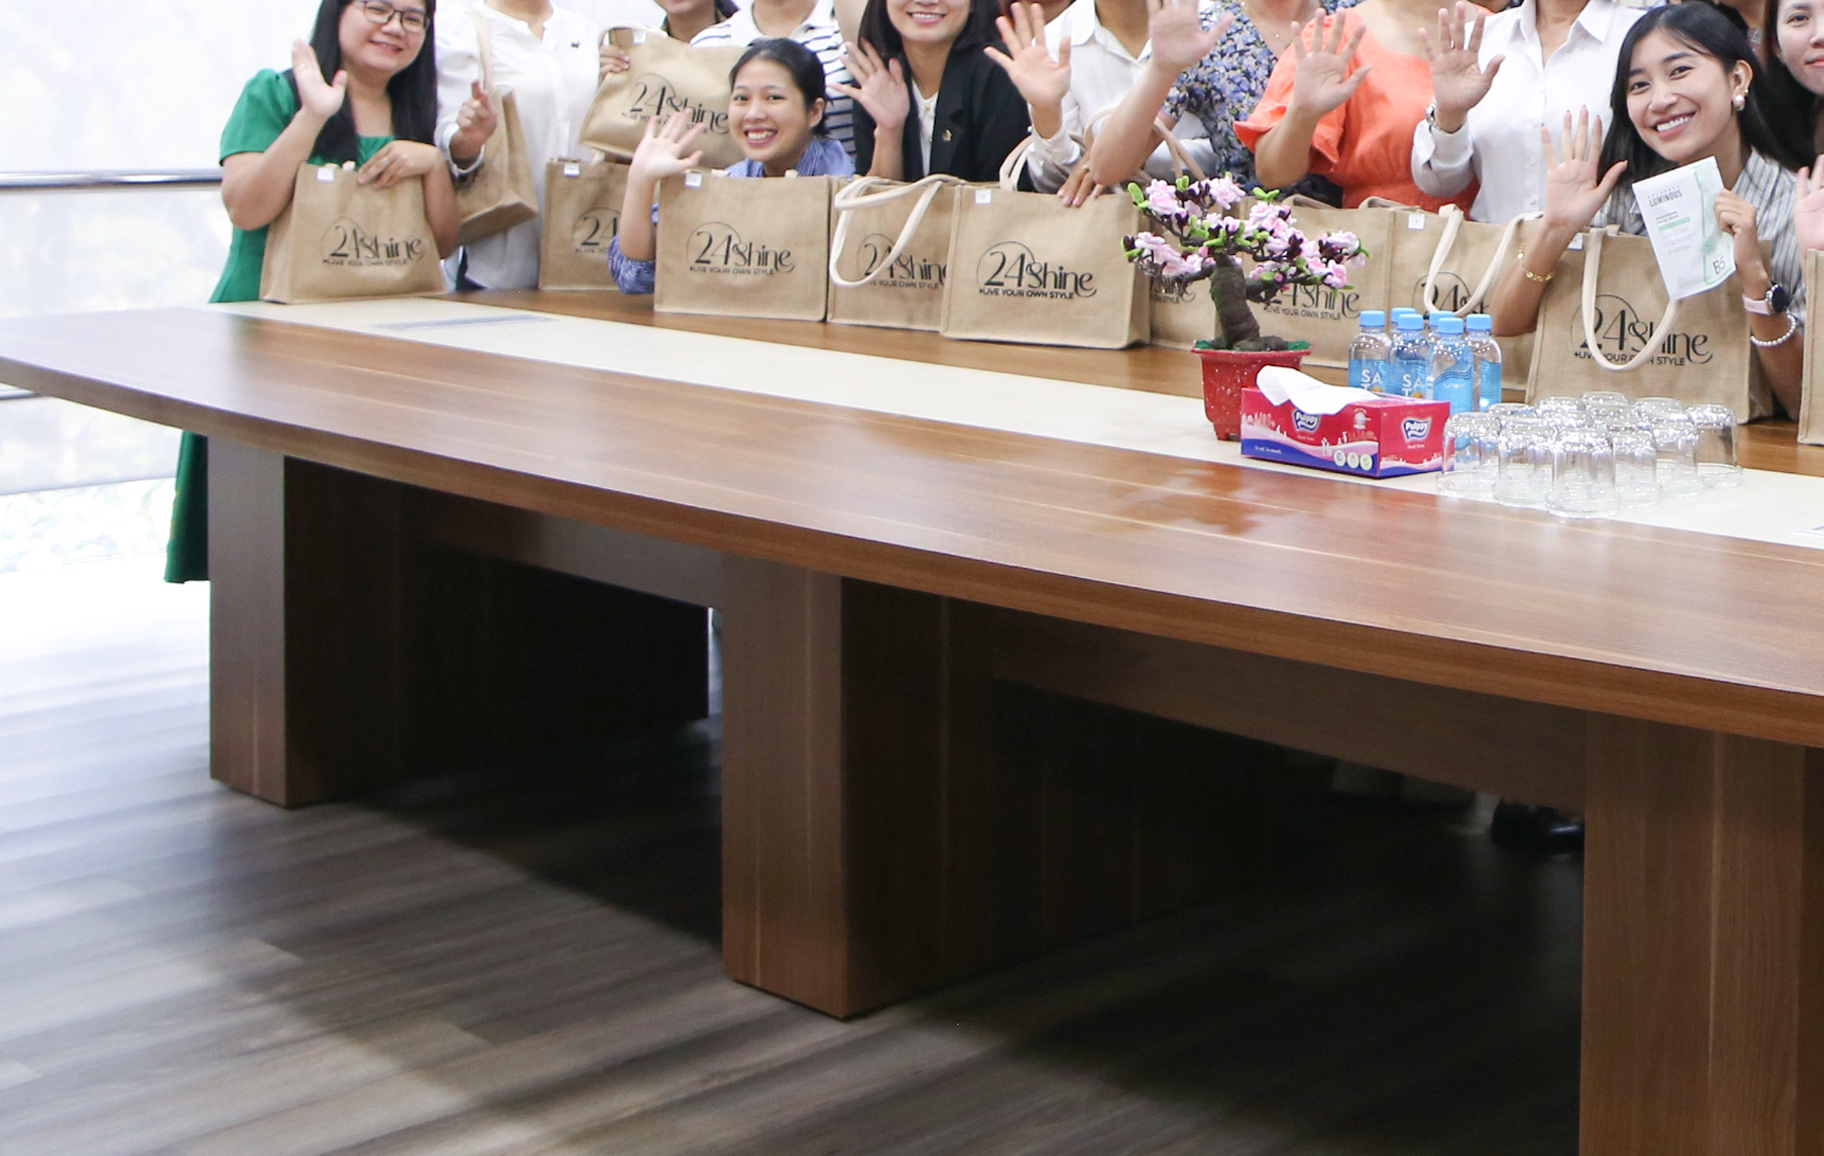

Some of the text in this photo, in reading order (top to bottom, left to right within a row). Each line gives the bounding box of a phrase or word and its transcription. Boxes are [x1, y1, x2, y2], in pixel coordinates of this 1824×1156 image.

[1649, 189, 1683, 207] LUMINOUS
[330, 225, 423, 260] 24Shine
[695, 231, 795, 273] 24Shine
[709, 266, 730, 274] YOUR
[732, 267, 751, 275] OWN
[753, 268, 775, 276] STYLE
[984, 251, 1097, 298] 24Shine
[983, 288, 1075, 300] LIVE YOUR OWN STYLE
[1282, 307, 1300, 316] YOUR
[1301, 309, 1319, 319] OWN
[1320, 311, 1341, 321] STYLE
[1657, 356, 1686, 366] STYLE
